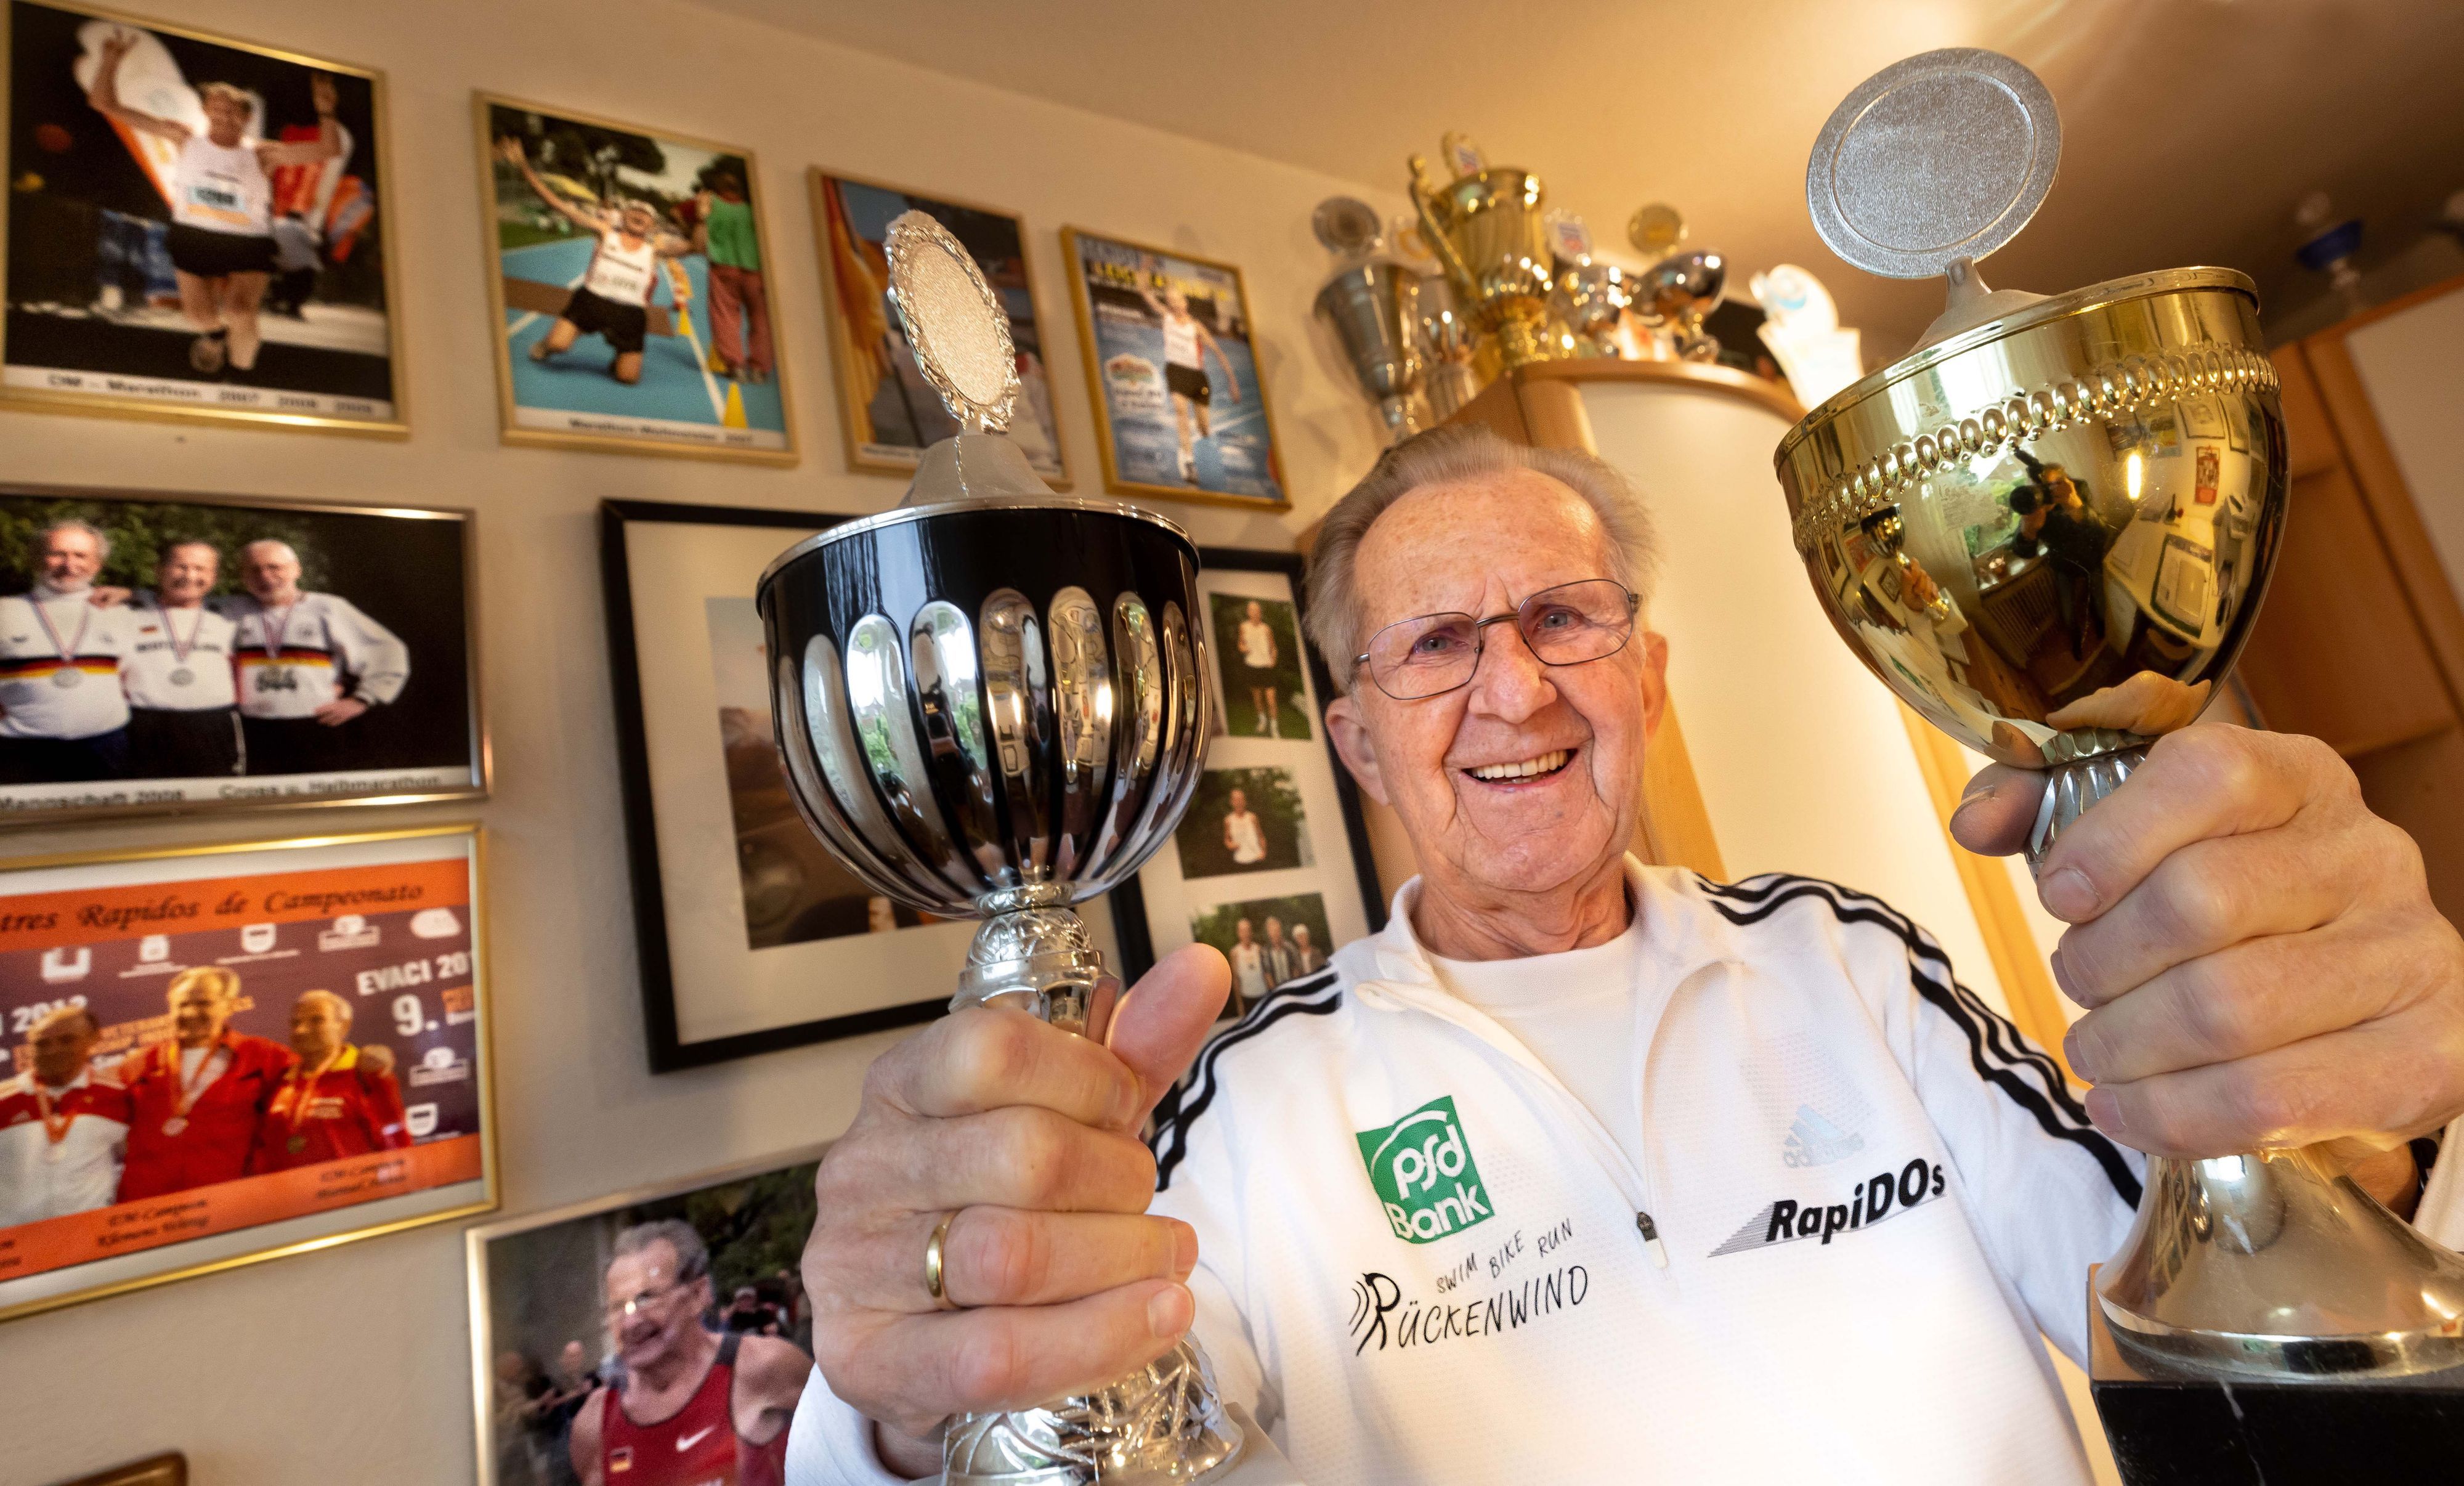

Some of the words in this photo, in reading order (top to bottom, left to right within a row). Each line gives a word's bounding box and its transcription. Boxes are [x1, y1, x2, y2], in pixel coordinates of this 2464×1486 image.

[76, 895, 199, 932] Rapidos
[214, 890, 248, 916] de
[263, 883, 424, 915] Campeonato
[355, 958, 432, 996] EVACI
[1392, 1123, 1467, 1200] psd
[1383, 1182, 1489, 1240] Bank
[1765, 1158, 1946, 1244] RapiDOs
[1436, 1253, 1479, 1294] SWIM
[1489, 1230, 1525, 1279] BIKE
[1537, 1218, 1573, 1257] RUN
[1355, 1265, 1589, 1357] RÜCKENWIND
